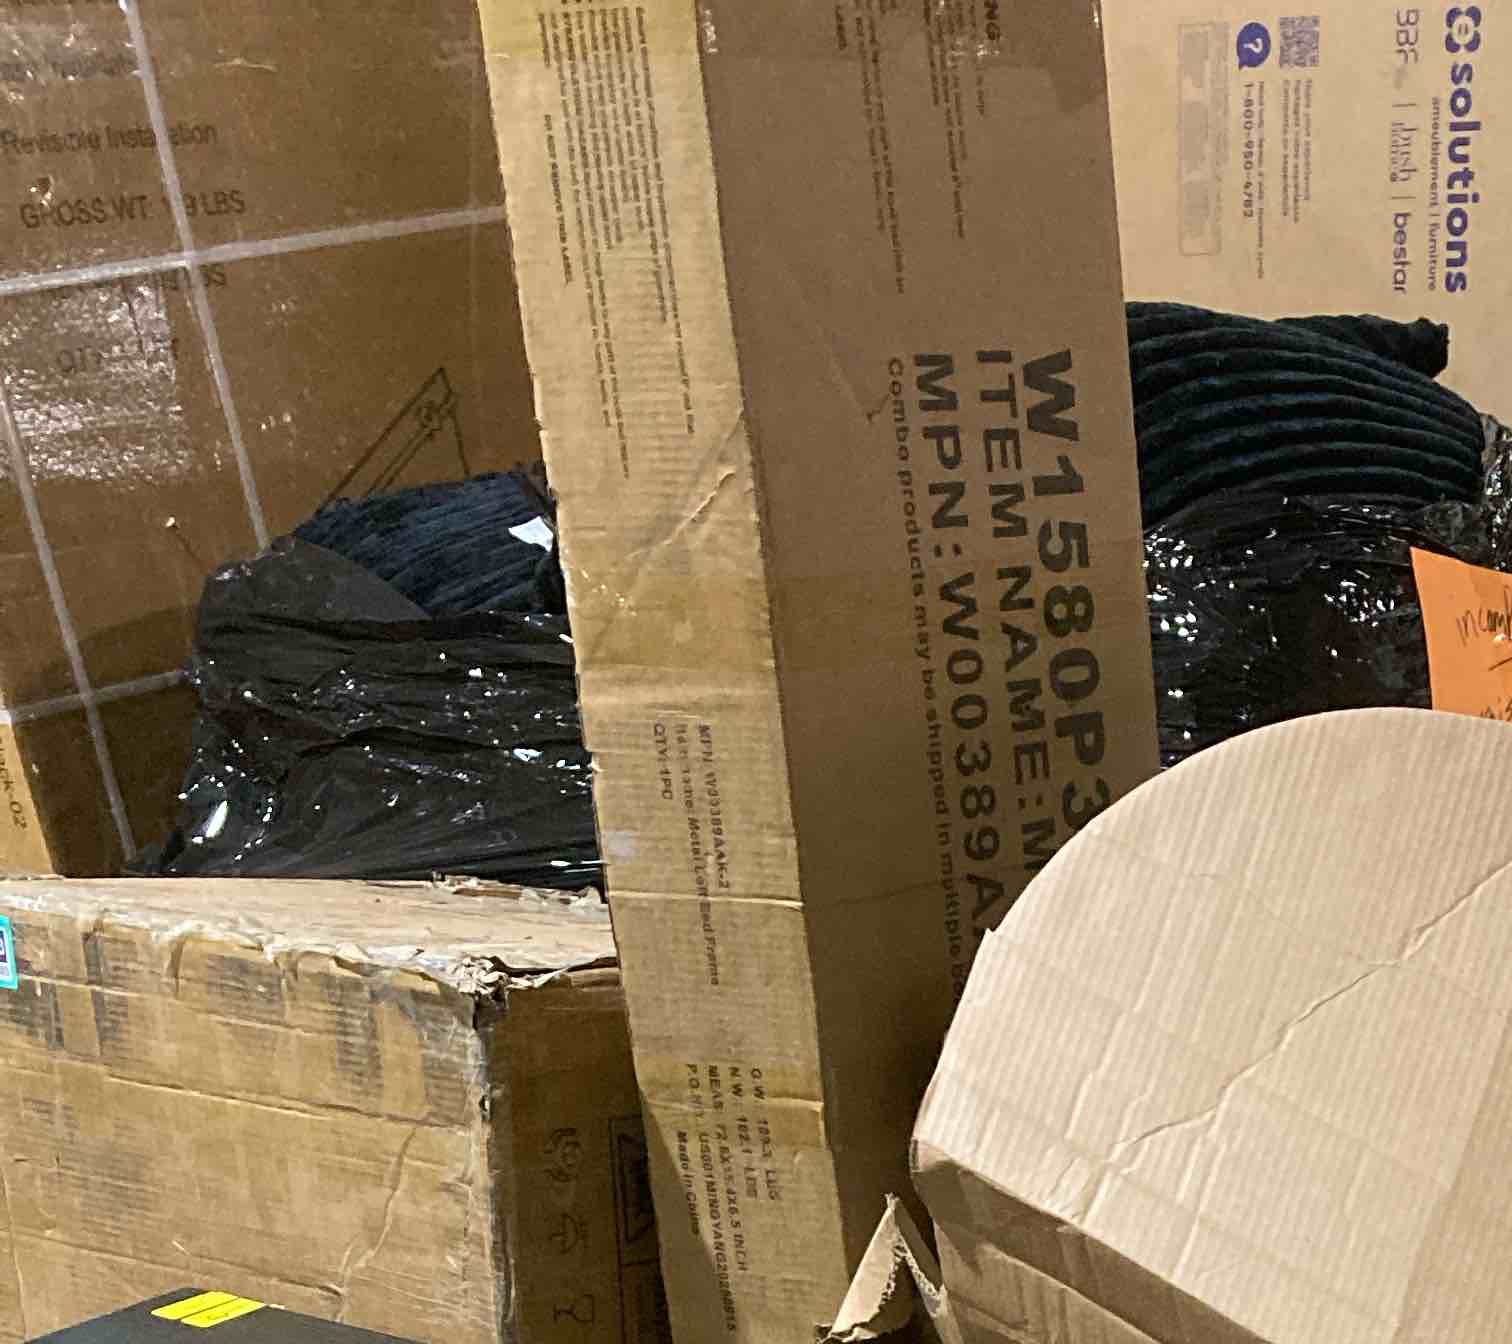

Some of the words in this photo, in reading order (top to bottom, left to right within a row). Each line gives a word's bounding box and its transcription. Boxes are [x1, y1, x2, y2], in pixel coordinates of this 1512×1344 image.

[102, 122, 214, 148] Instaation
[1429, 96, 1441, 206] ameublement
[1445, 62, 1482, 293] solutions
[19, 198, 106, 229] GROSS
[198, 189, 245, 216] LBS
[1391, 212, 1412, 293] bestar
[1427, 222, 1440, 290] furniture
[886, 357, 912, 460] Combo
[977, 347, 1027, 538] ITEM
[897, 468, 925, 596] products
[910, 604, 932, 659] may
[914, 350, 1009, 939] MPN:W00389A
[920, 668, 937, 699] be
[922, 709, 949, 813] shipped
[936, 821, 951, 843] in
[687, 814, 706, 861] Metal
[704, 934, 721, 983] Frame
[937, 850, 964, 960] multiple
